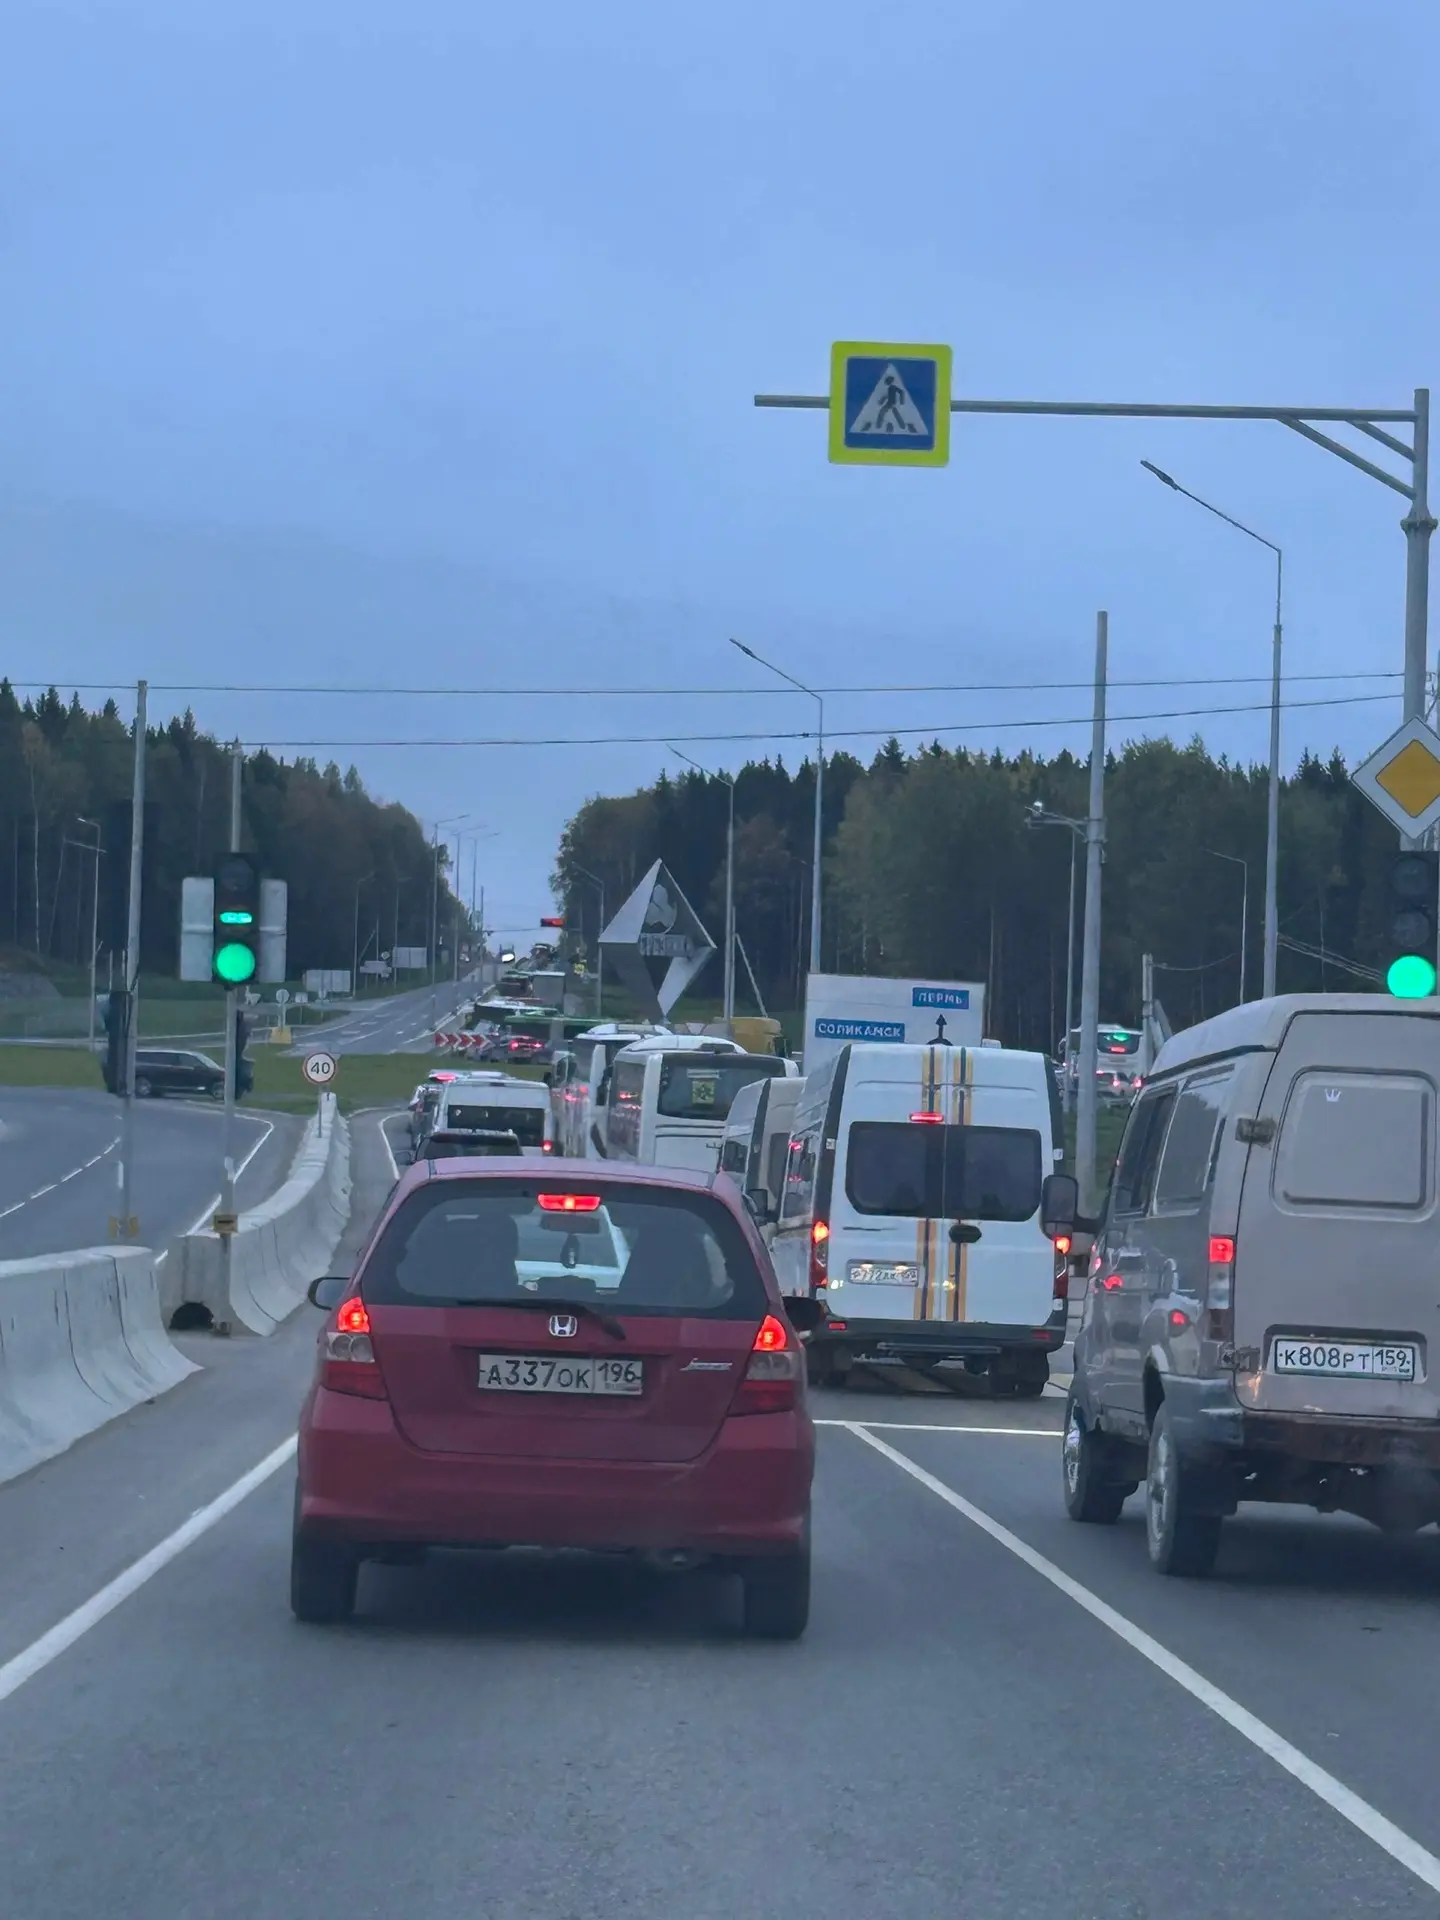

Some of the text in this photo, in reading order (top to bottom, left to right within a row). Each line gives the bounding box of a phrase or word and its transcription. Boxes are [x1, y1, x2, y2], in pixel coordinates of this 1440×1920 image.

[918, 992, 963, 1005] ПЕРМЬ
[818, 1023, 901, 1037] СОЛИКАМСК
[310, 1062, 331, 1075] 40
[1374, 1348, 1407, 1367] 159
[597, 1362, 637, 1383] 196
